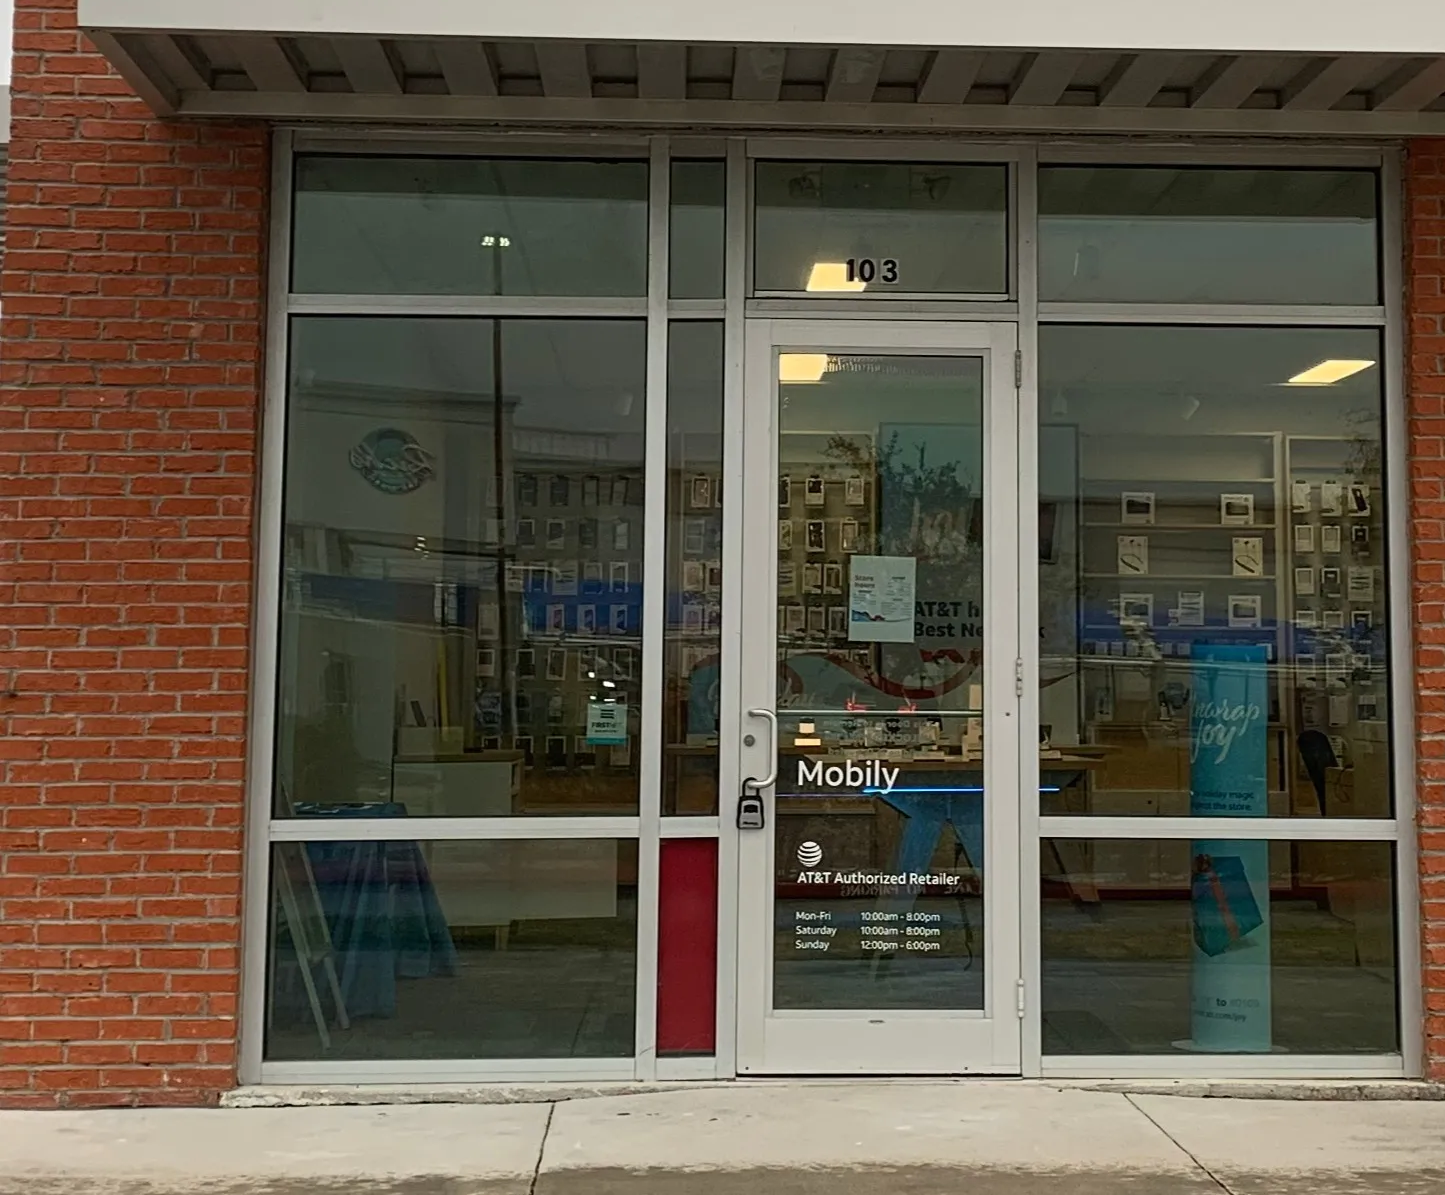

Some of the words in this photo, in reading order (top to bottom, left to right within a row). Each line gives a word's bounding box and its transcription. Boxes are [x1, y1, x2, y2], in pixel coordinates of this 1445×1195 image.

[846, 258, 898, 283] 103
[914, 601, 962, 618] AT&T
[914, 622, 956, 637] Best
[797, 759, 900, 795] Mobily
[797, 872, 832, 884] AT&T
[834, 872, 906, 885] Authorized
[909, 873, 960, 885] Retailer
[795, 911, 832, 921] Mon-Fri
[860, 911, 898, 921] 10:00am
[795, 926, 837, 937] Saturday
[860, 926, 898, 935] 10:00am
[906, 926, 940, 937] 8:00pm
[795, 940, 830, 951] Sunday
[860, 940, 899, 951] 12:00pm
[906, 940, 940, 951] 6:00pm
[1216, 997, 1227, 1007] to
